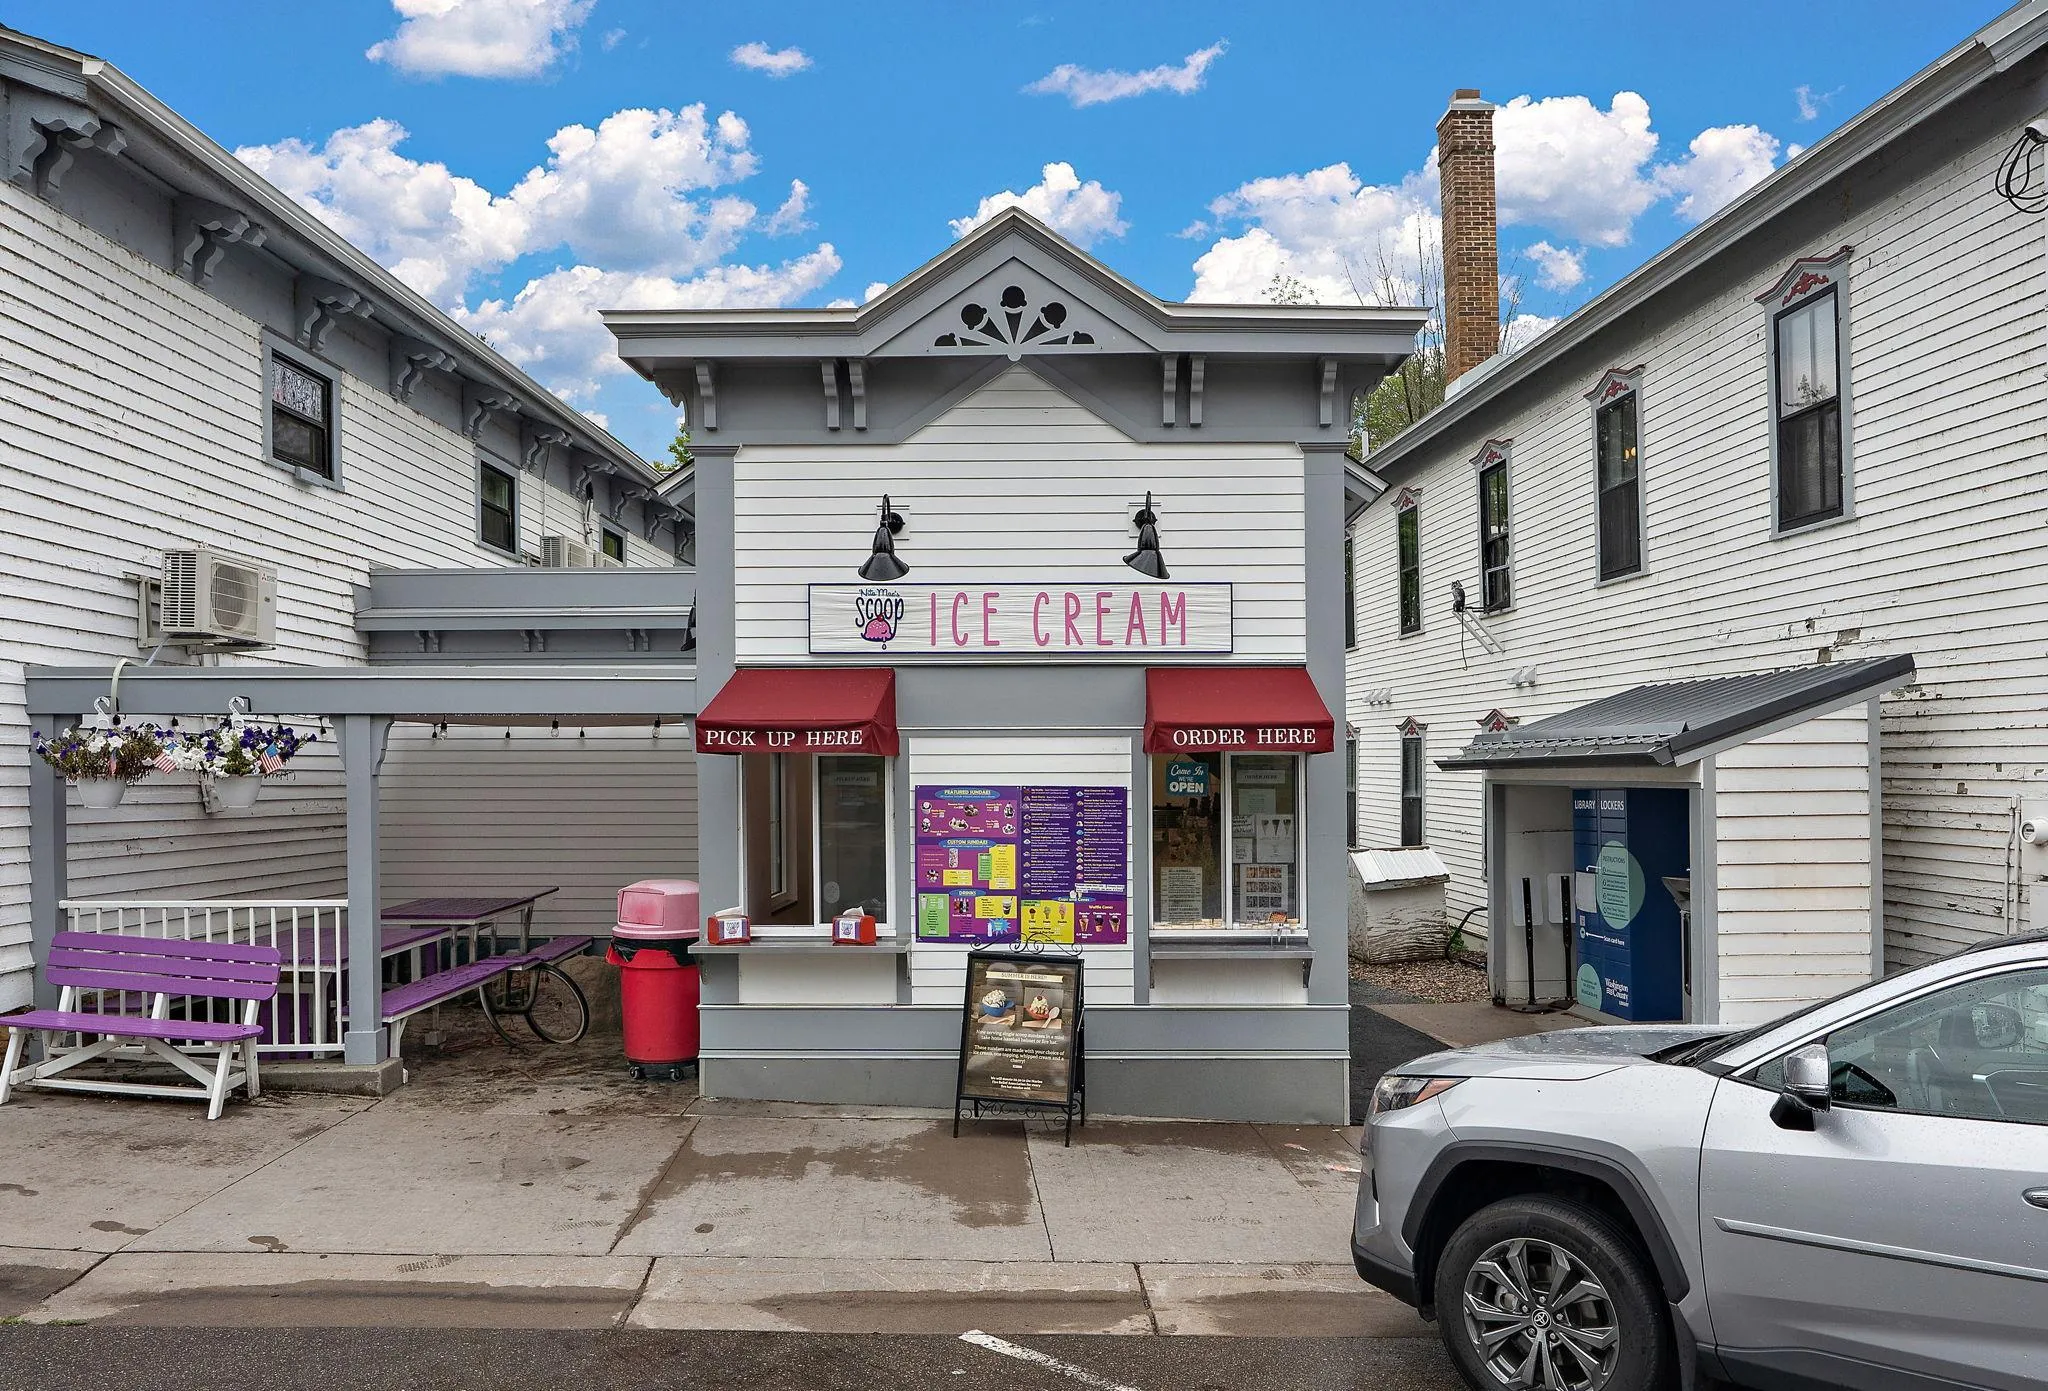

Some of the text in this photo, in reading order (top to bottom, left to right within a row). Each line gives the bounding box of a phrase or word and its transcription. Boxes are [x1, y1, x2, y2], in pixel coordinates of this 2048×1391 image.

[930, 591, 1188, 647] ICE CREAM
[704, 730, 863, 747] PICK UP HERE
[1172, 728, 1316, 746] ORDER HERE
[1171, 764, 1192, 776] Come
[1170, 782, 1204, 794] OPEN
[1574, 800, 1596, 810] LIBRARY
[1600, 800, 1624, 810] LOCKERS
[1604, 978, 1628, 992] Washington
[1613, 991, 1628, 1002] County
